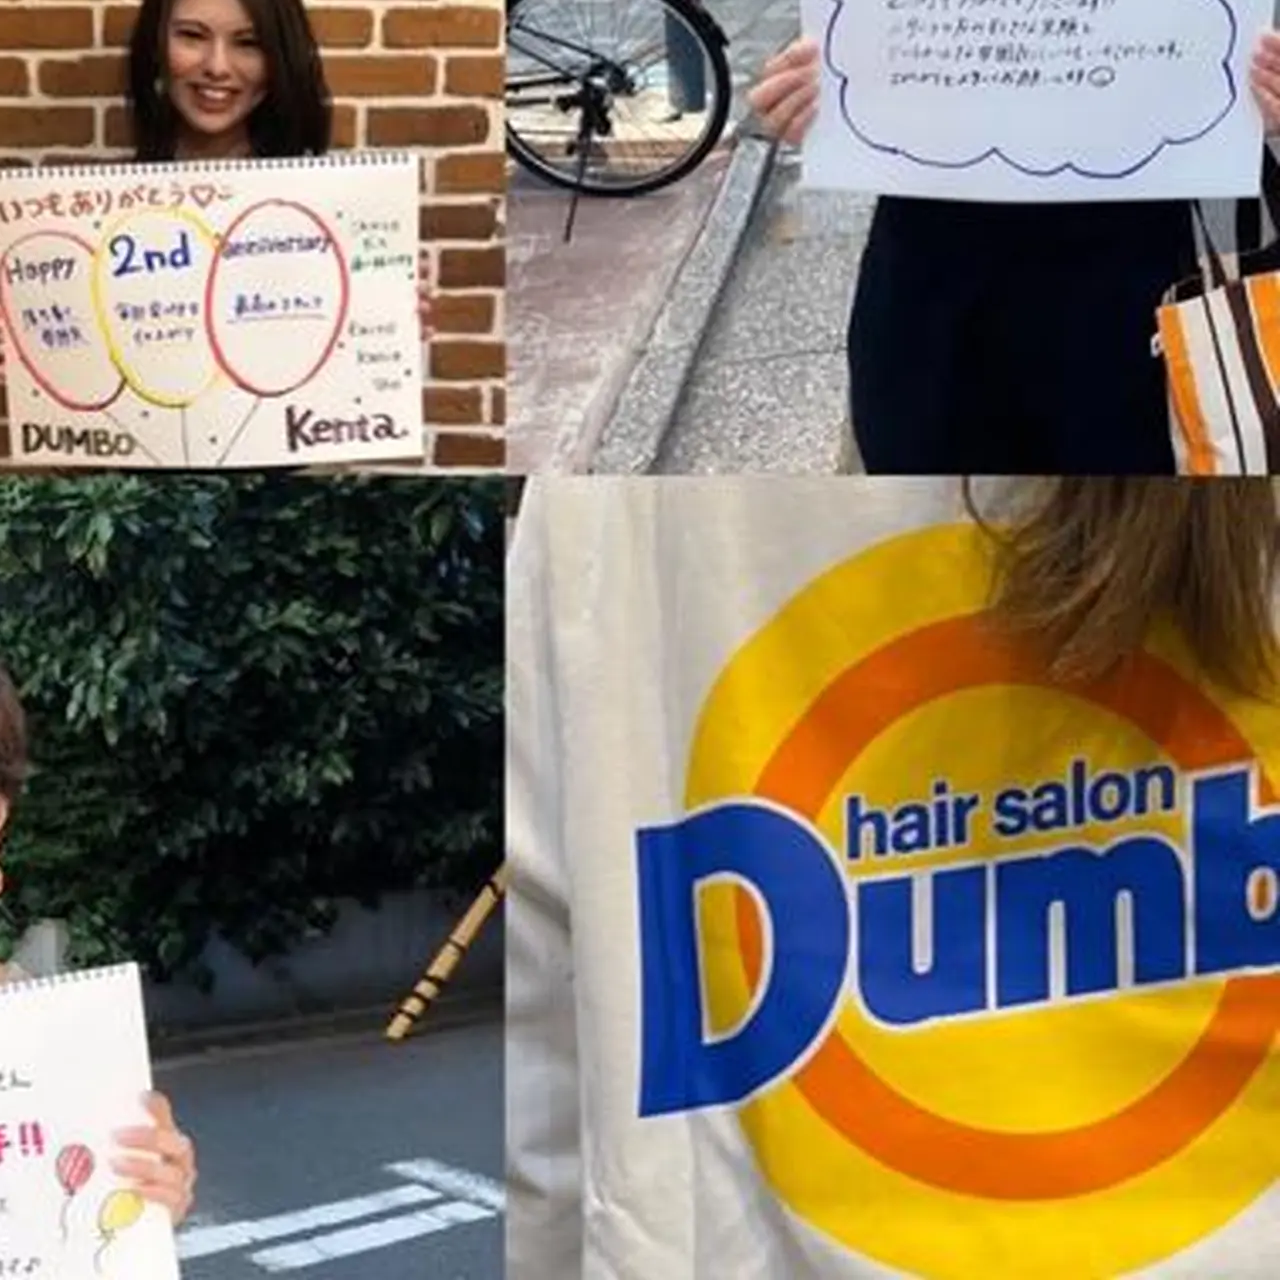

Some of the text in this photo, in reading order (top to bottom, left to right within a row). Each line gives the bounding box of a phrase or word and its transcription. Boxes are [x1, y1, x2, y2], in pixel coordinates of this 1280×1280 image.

[109, 231, 193, 278] 2nd
[21, 422, 136, 456] DUMBO
[846, 760, 1178, 861] hair salon
